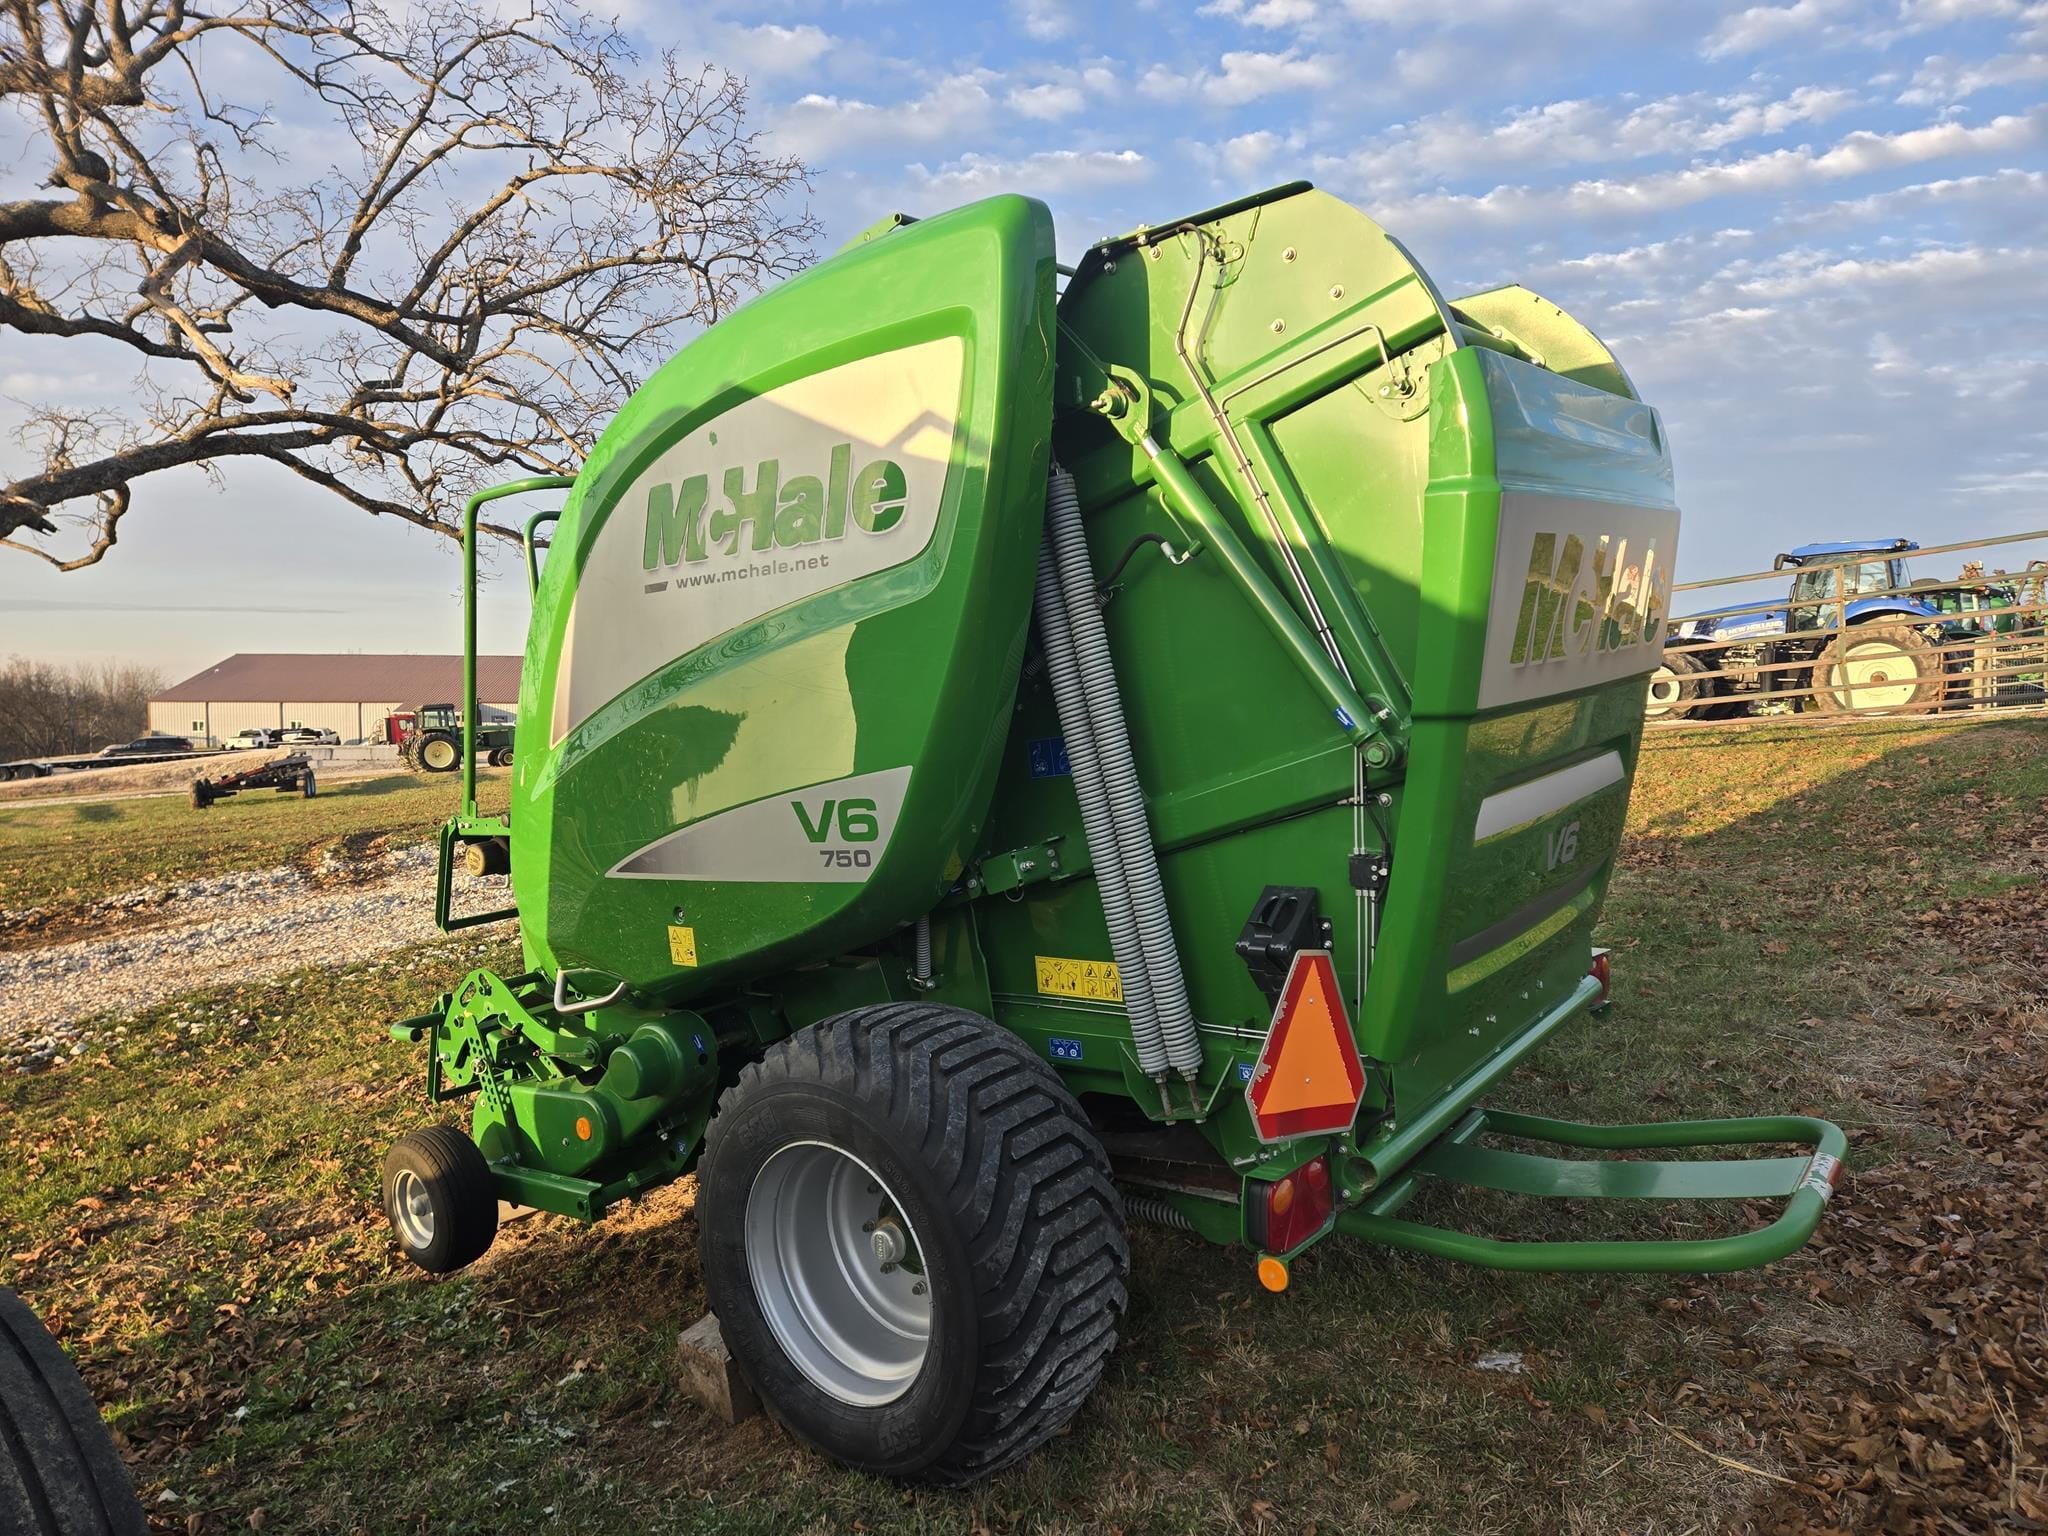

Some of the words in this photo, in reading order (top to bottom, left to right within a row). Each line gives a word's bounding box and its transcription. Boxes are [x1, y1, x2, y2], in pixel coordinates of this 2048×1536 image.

[642, 442, 908, 570] McHale
[675, 553, 830, 590] www.mchale.net
[1509, 531, 1666, 665] McHale
[790, 798, 879, 843] V6
[819, 849, 871, 868] 750
[1547, 820, 1581, 871] V6
